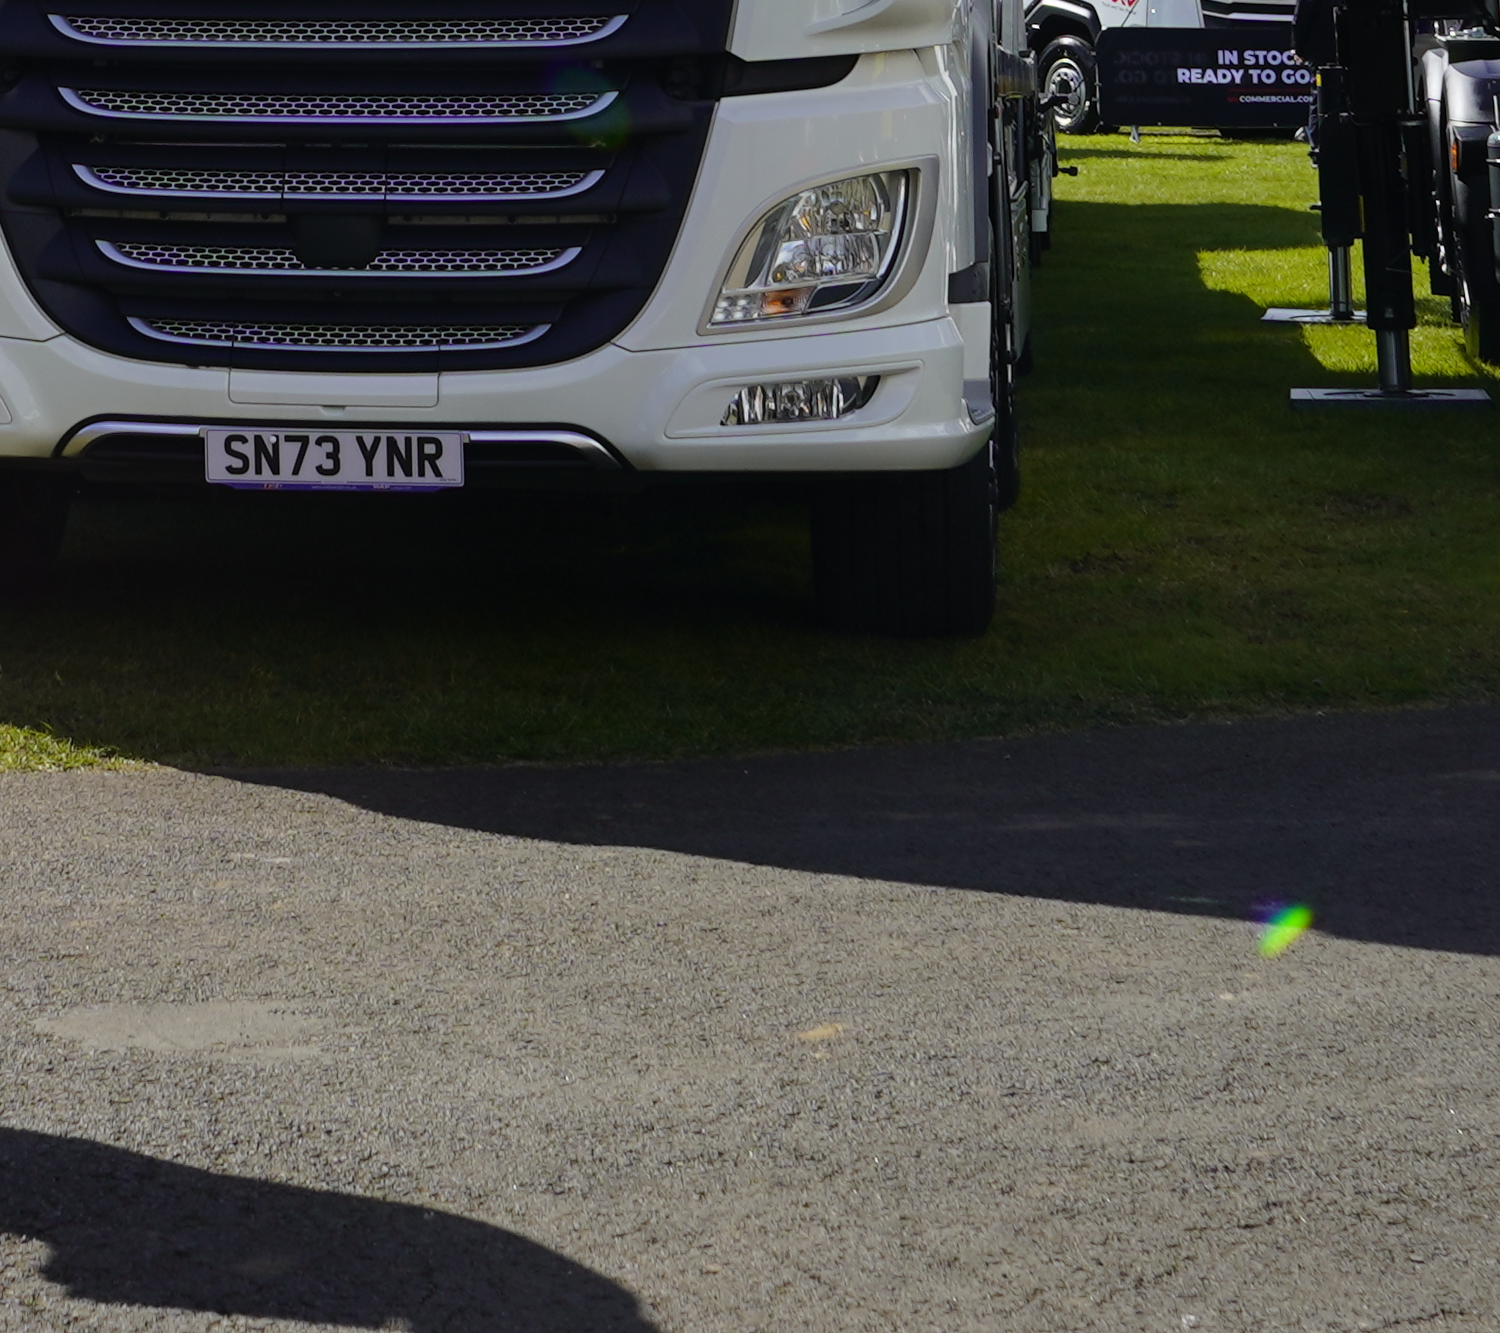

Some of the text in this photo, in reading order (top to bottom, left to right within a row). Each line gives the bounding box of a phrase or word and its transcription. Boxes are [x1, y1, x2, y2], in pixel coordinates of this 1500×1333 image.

[1217, 50, 1298, 65] IN STOC
[1177, 68, 1243, 84] READY
[1249, 68, 1275, 84] TO
[224, 434, 443, 478] SN73 YNR
